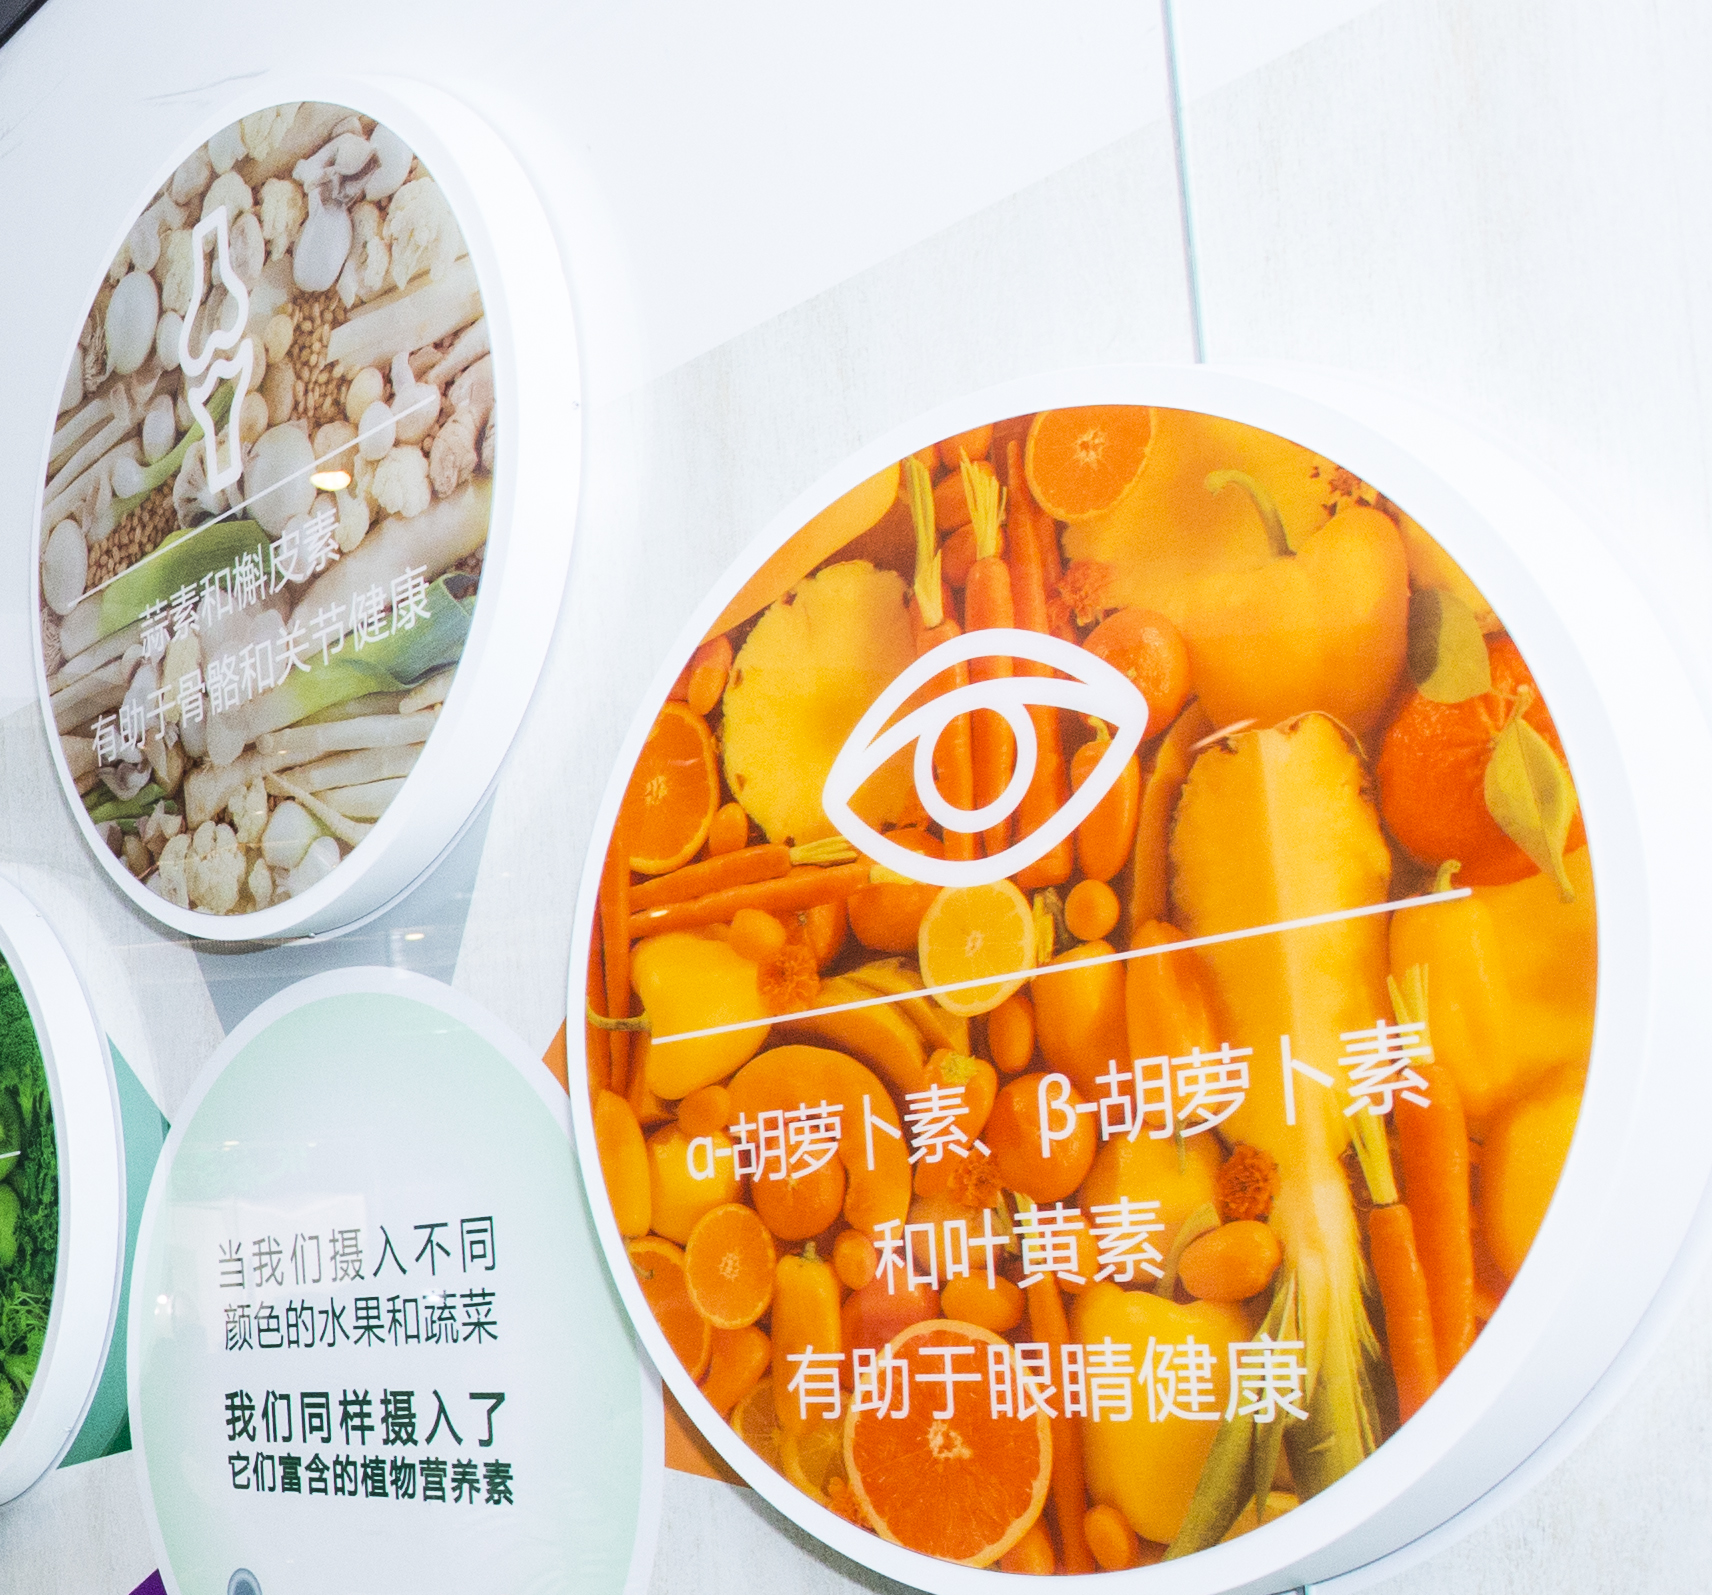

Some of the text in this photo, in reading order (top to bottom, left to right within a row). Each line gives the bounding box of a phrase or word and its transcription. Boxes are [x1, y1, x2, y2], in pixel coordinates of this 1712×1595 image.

[138, 507, 341, 659] 蒜素和槲皮素
[90, 564, 432, 767] 有助于骨骼和关节健康
[218, 1215, 496, 1290] 当我们摄入不同
[874, 1196, 1168, 1297] 和叶黄素
[224, 1288, 498, 1351] 颜色的水果和蔬菜
[224, 1388, 506, 1448] 我们同样摄入了
[786, 1332, 1310, 1425] 有助于眼睛健康
[227, 1451, 514, 1506] 它们富含的植物营养素
